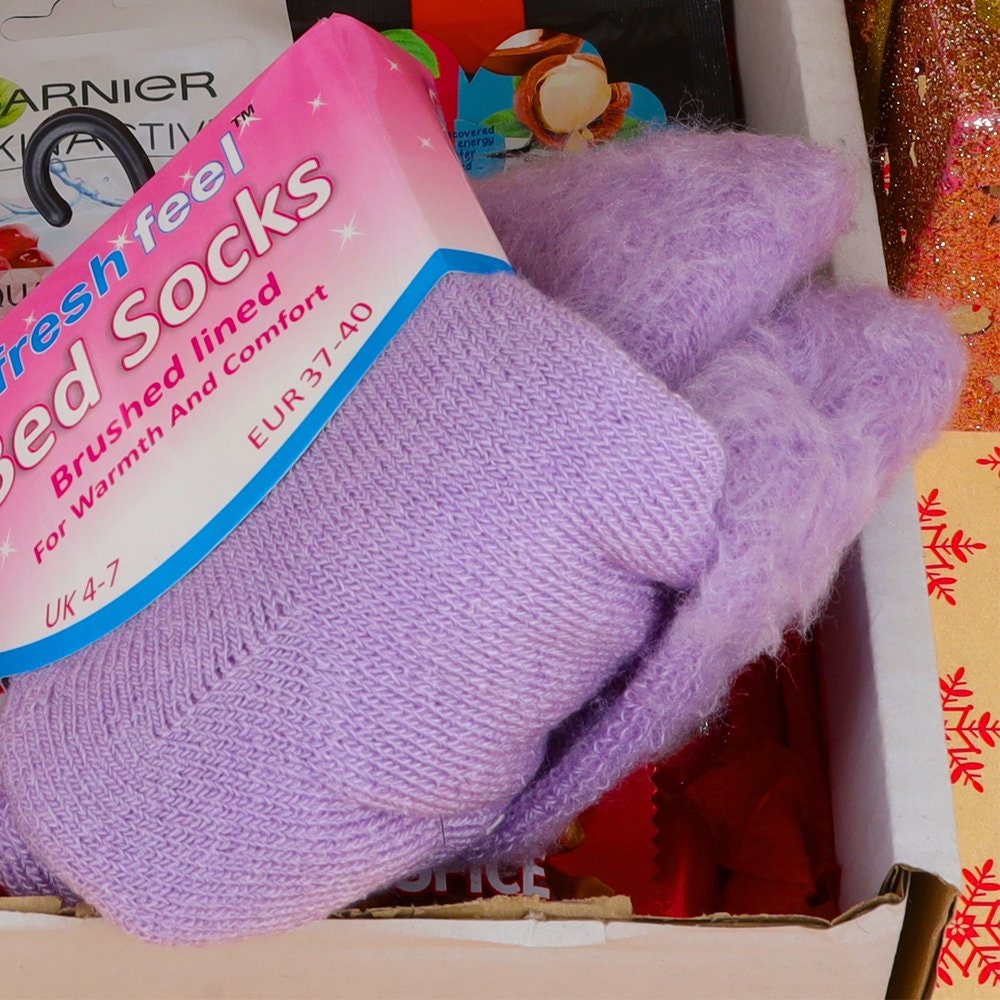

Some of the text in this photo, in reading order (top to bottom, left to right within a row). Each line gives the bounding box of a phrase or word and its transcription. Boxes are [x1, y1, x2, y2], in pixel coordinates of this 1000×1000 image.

[112, 156, 334, 372] Socks
[133, 130, 245, 255] feel
[33, 284, 329, 565] For Warmth And Comfort
[49, 271, 282, 499] Brushed lined
[247, 302, 373, 450] EUR 37-40
[45, 558, 120, 628] UK 4-7
